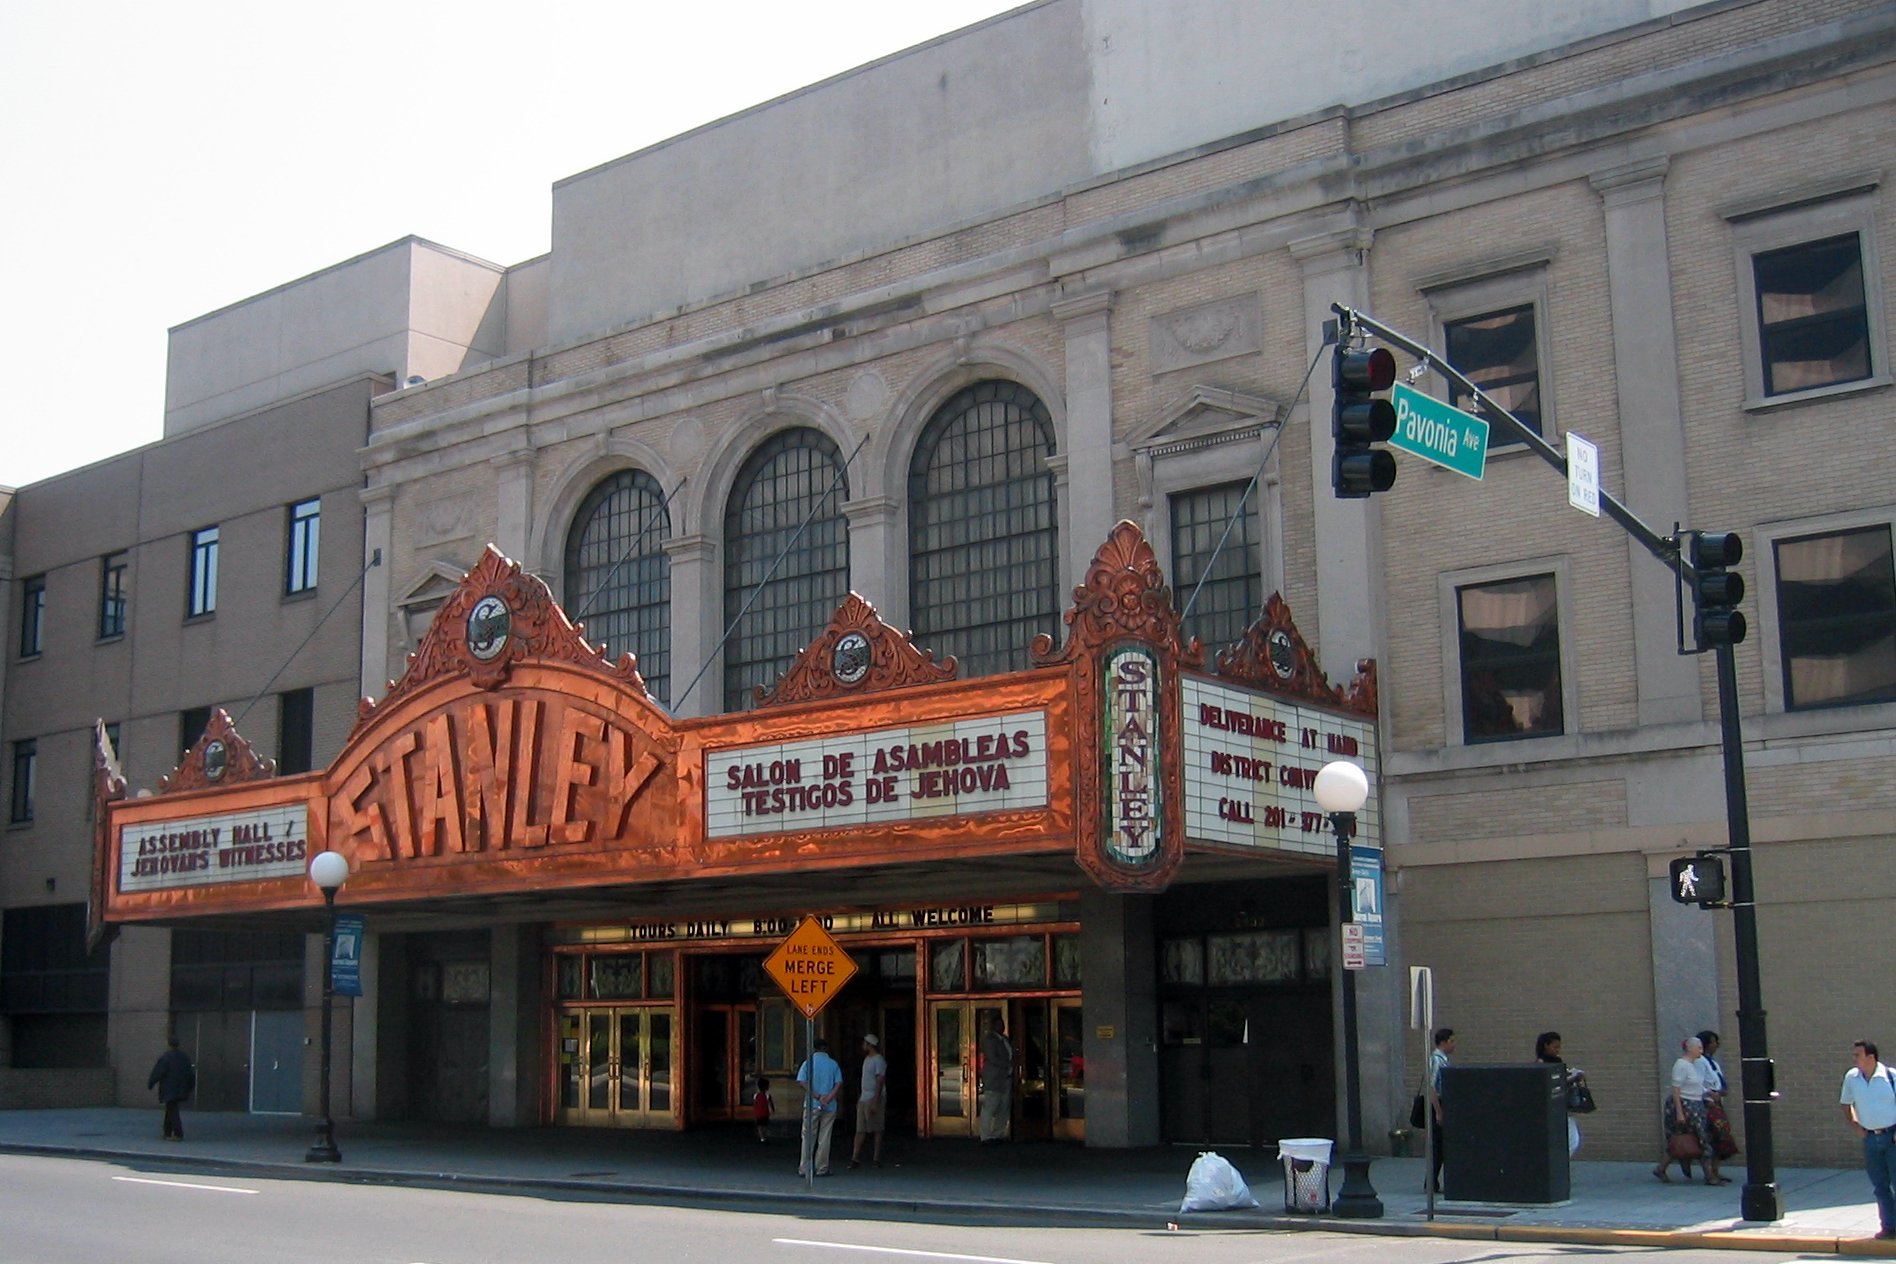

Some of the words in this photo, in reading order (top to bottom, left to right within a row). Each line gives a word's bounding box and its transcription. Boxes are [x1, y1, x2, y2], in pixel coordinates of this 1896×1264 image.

[1396, 398, 1458, 457] Pavonia
[1462, 427, 1480, 451] Ave
[1577, 447, 1588, 463] NO
[1571, 482, 1581, 499] ON
[1575, 464, 1593, 484] TURN
[1200, 702, 1287, 744] DELIVERANCE
[1301, 727, 1317, 750] AT
[1327, 732, 1359, 758] HAND
[728, 758, 800, 790] SALON
[823, 752, 854, 780] DE
[872, 730, 1030, 775] ASAMBLEAS
[1118, 661, 1150, 848] STANLEY
[1211, 750, 1272, 783] DISTRICT
[1280, 765, 1319, 791] CONV
[330, 699, 660, 864] STANLEY
[740, 780, 853, 818] TESTIGOS
[866, 776, 899, 804] DE
[911, 763, 1010, 800] JEHOVA
[1218, 797, 1254, 825] CALL
[139, 828, 220, 856] ASSEMBLY
[232, 822, 272, 845] HALL
[219, 839, 306, 869] WITNESSES
[630, 924, 675, 940] TOURS
[687, 921, 728, 938] DAILY
[872, 912, 898, 929] ALL
[912, 904, 994, 927] WELCOME
[785, 960, 835, 975] MERGE
[787, 945, 807, 955] LANE
[812, 945, 834, 956] ENDS
[791, 980, 828, 994] LEFT
